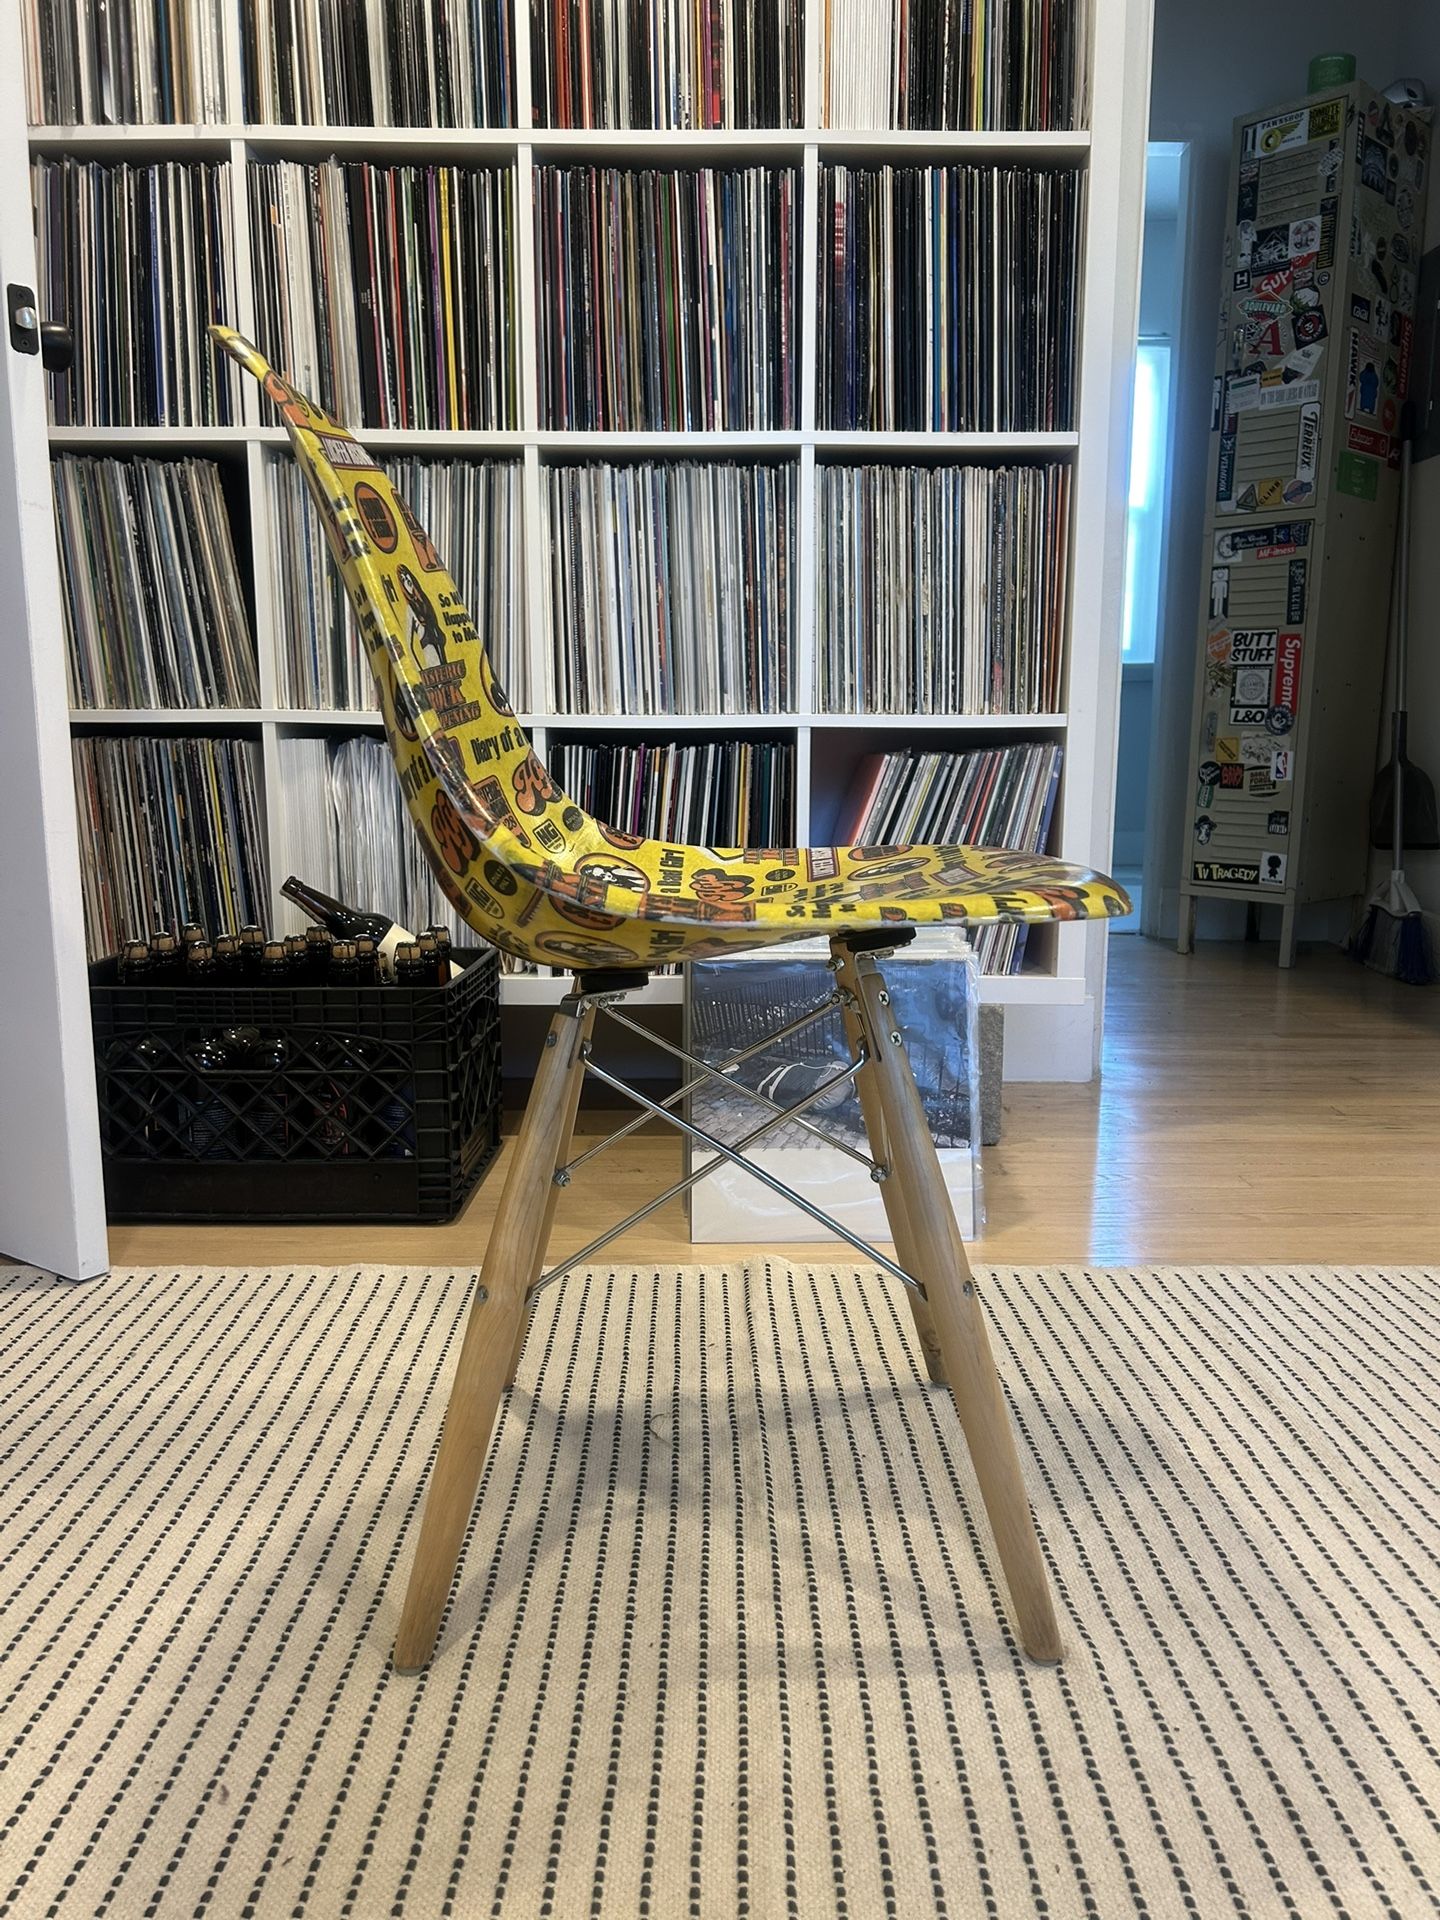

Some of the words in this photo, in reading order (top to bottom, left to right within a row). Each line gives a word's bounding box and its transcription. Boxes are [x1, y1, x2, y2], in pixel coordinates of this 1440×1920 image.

[1261, 112, 1304, 129] PAWNSHOP
[1301, 411, 1318, 467] TERREUX
[438, 593, 451, 608] So
[452, 630, 463, 644] to
[1233, 631, 1276, 647] BUTT
[1230, 647, 1275, 662] STUFF
[1233, 710, 1266, 723] L&O
[470, 737, 501, 765] Diary
[499, 725, 514, 753] of
[514, 727, 525, 748] a
[536, 822, 559, 846] HG
[660, 848, 685, 867] Girl
[657, 868, 683, 887] Bad
